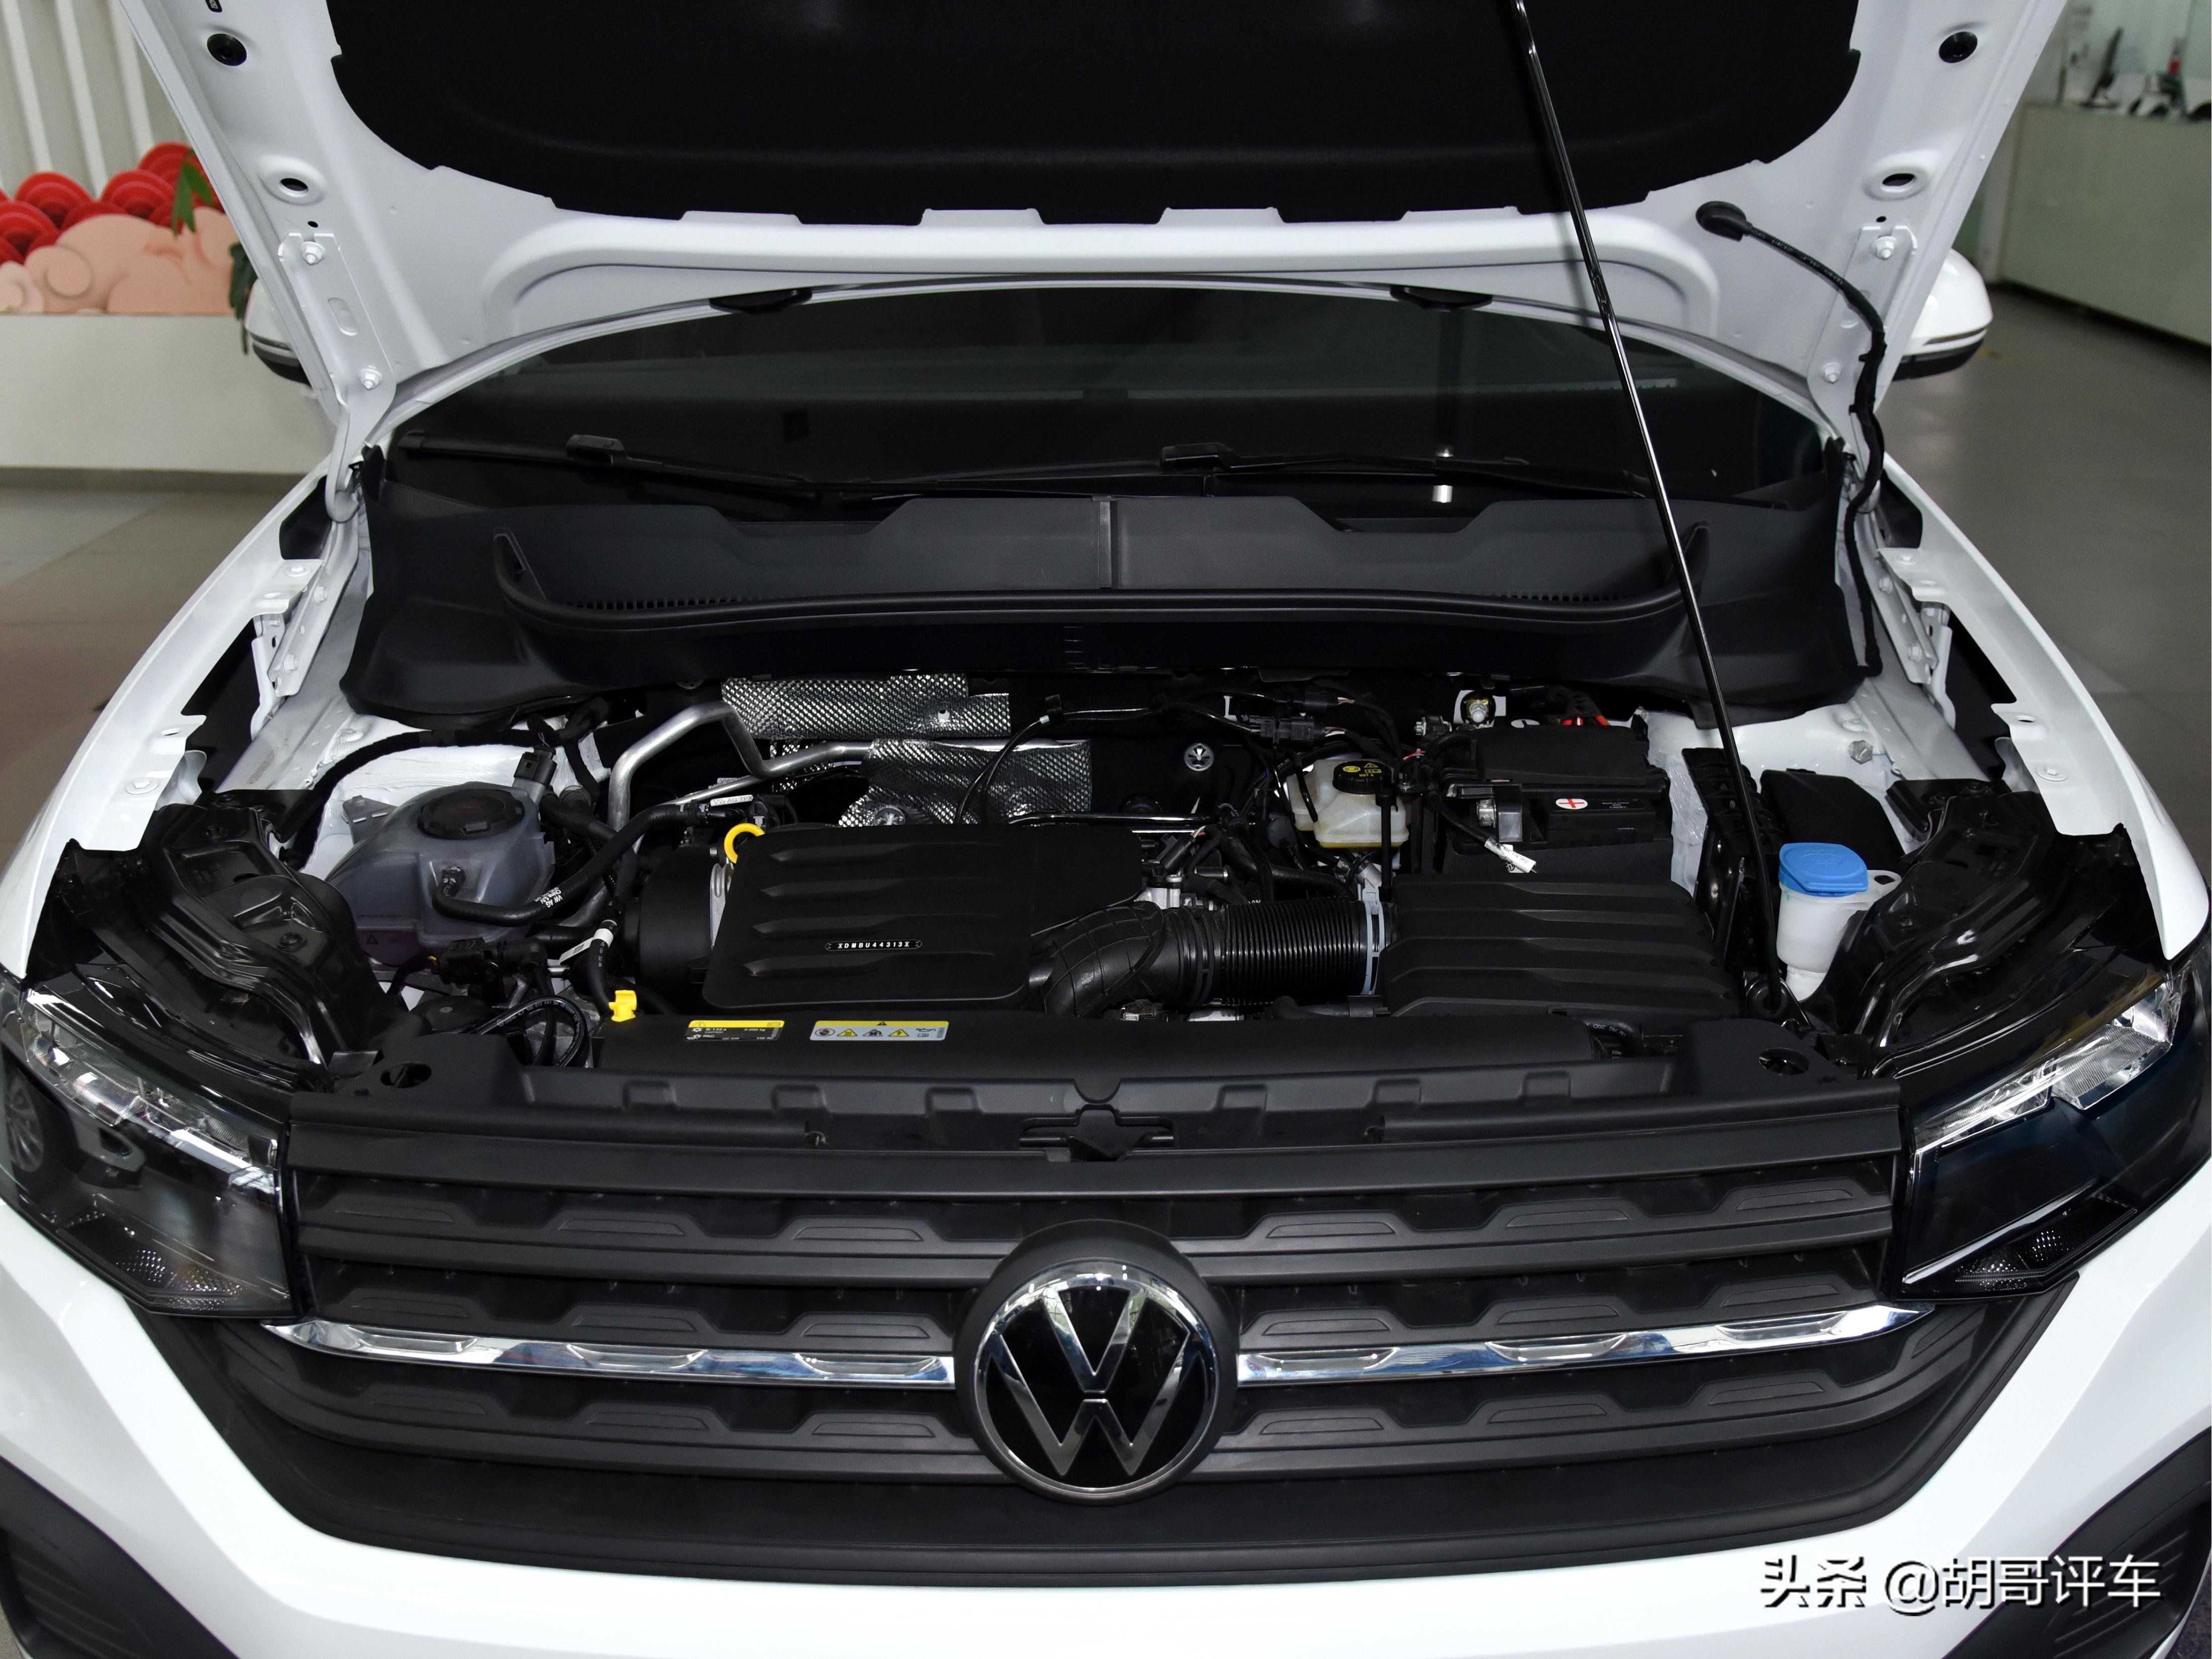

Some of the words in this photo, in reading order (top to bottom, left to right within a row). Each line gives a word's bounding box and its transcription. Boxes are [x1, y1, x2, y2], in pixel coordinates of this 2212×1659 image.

[554, 894, 563, 903] VW
[545, 899, 554, 908] AG
[988, 1282, 1204, 1477] VW
